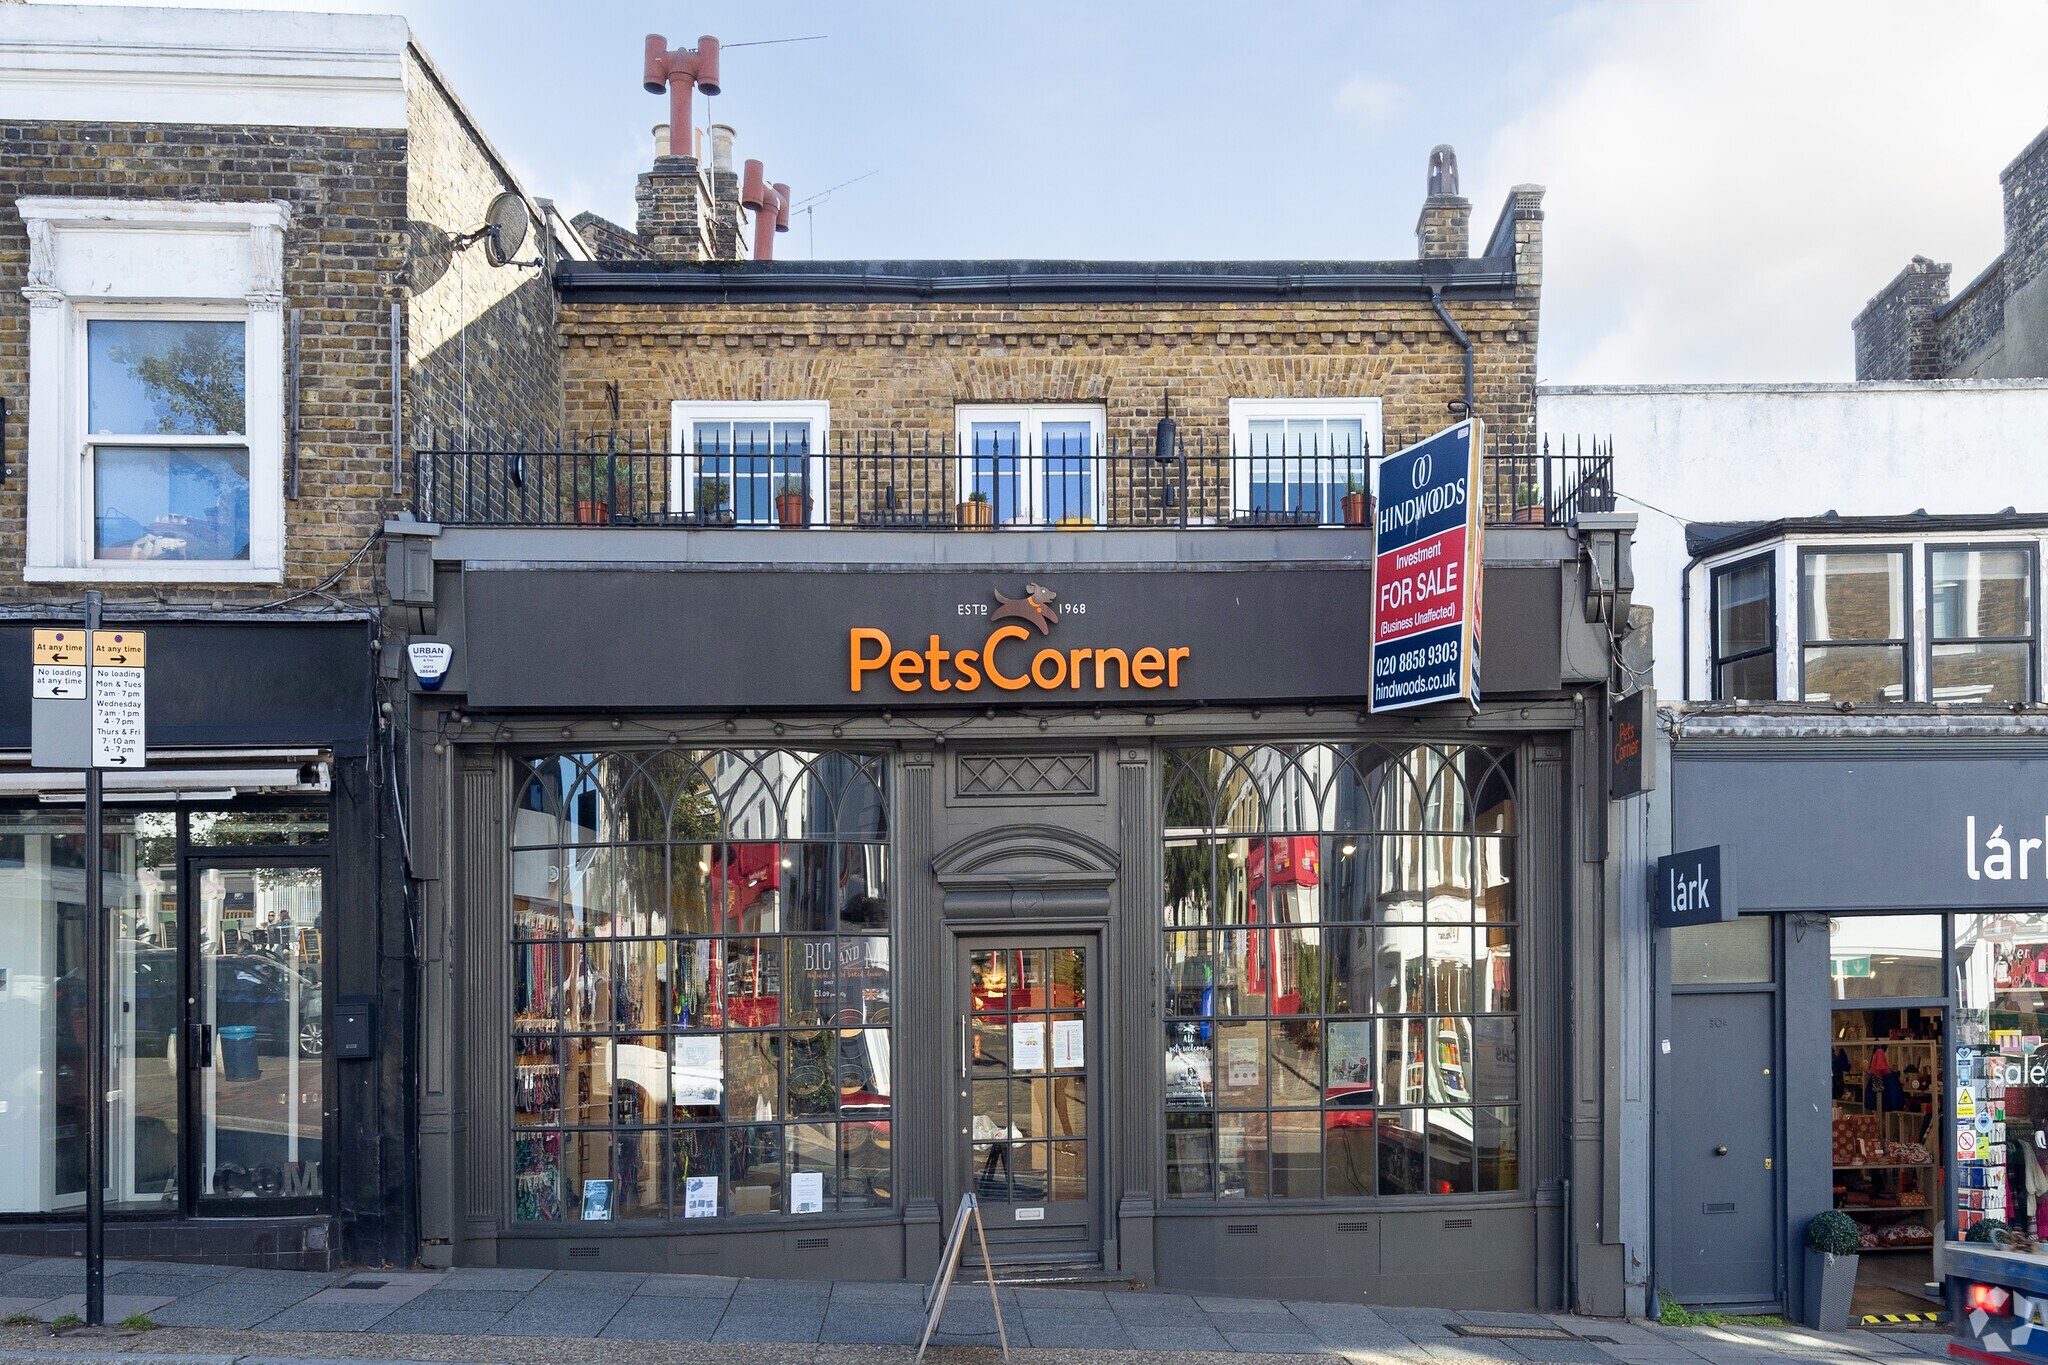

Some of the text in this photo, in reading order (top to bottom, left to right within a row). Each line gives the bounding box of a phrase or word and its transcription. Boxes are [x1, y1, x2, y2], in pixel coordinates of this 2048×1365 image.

[1379, 478, 1466, 535] HINDWOODS
[1396, 540, 1442, 570] Investment
[1380, 562, 1458, 612] FOR SALE
[957, 603, 1087, 616] ESTD 1968
[1380, 602, 1455, 637] (Business Unaffected)
[52, 669, 82, 678] loading
[850, 625, 1190, 692] PetsCorner
[1376, 640, 1458, 677] 020 8858 9303
[112, 670, 141, 679] loading
[1375, 668, 1456, 701] hindwoods.co.uk
[96, 700, 142, 709] Wednesday
[97, 728, 119, 736] Thurs
[130, 728, 141, 736] Fri
[1620, 722, 1635, 743] Pets
[1614, 740, 1639, 765] Corner
[1967, 815, 2048, 880] lár
[1670, 863, 1710, 913] lárk
[840, 946, 860, 965] AND
[814, 989, 830, 998] £1.09
[1993, 1053, 2045, 1085] sale
